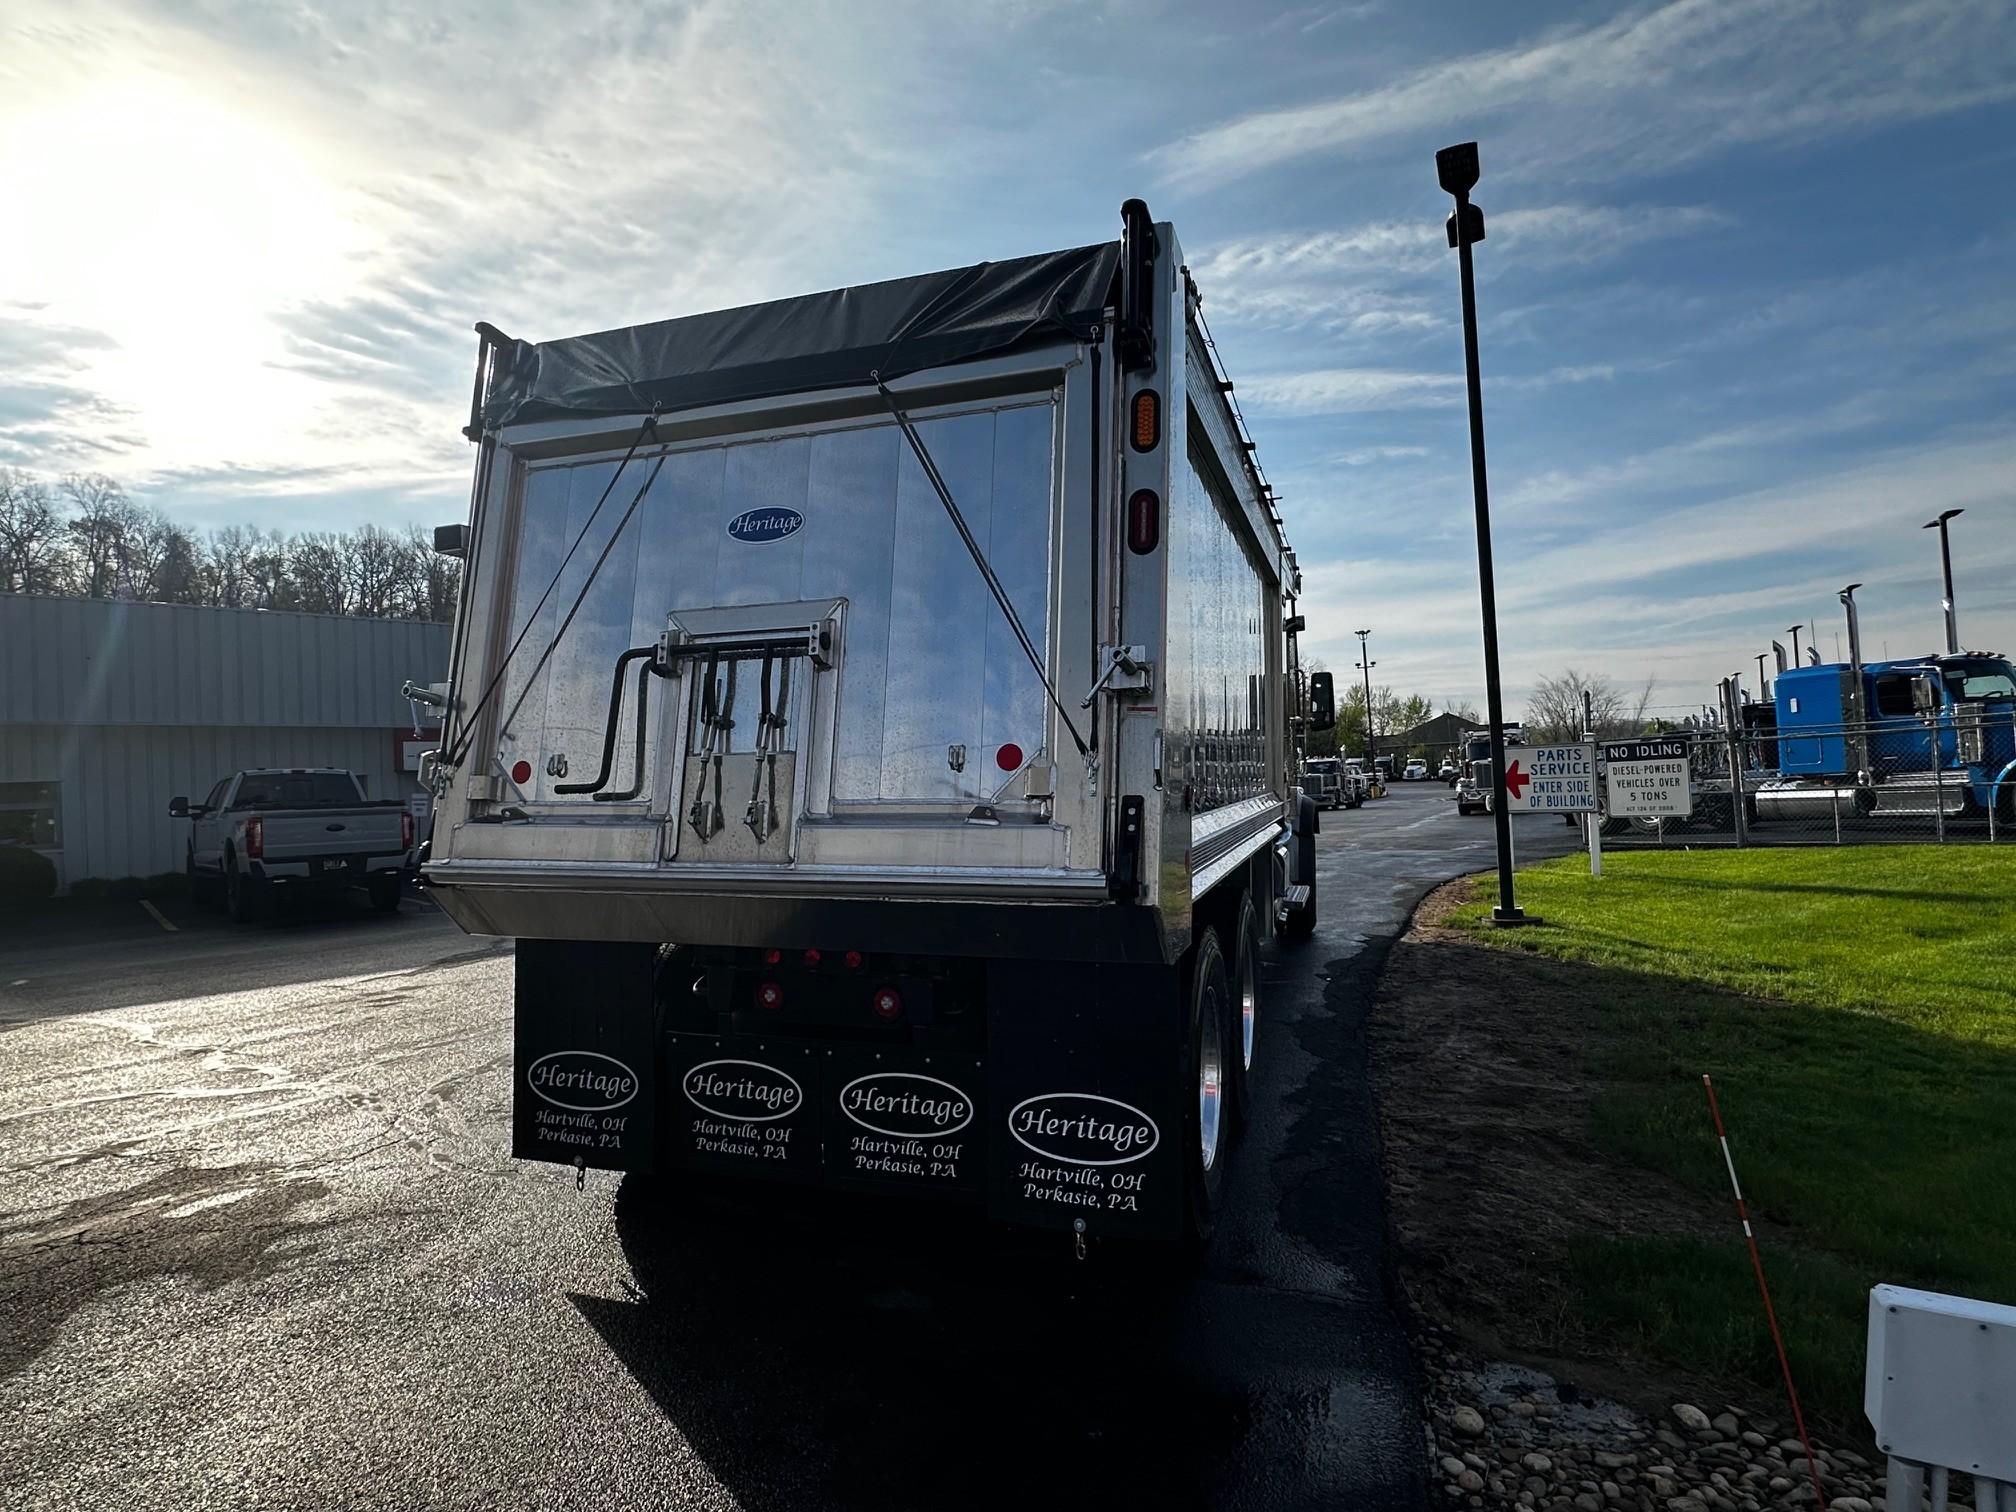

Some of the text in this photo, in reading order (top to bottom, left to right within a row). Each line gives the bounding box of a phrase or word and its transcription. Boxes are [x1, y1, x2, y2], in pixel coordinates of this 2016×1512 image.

[730, 513, 801, 534] Heritage
[1537, 748, 1582, 761] PARTS
[1610, 743, 1682, 758] NO IDLING
[1530, 762, 1591, 776] SERVICE
[1612, 764, 1682, 776] DIESEL-POWERED
[1533, 781, 1590, 793] ENTER SIDE
[1616, 777, 1680, 788] VEHICLES OVER
[1530, 794, 1594, 807] OF BUILDING
[1630, 791, 1668, 801] 5 TONS
[534, 1064, 631, 1099] Heritage
[690, 1073, 794, 1110] Heritage
[848, 1087, 964, 1125] Heritage
[534, 1110, 628, 1132] Hartville, OH
[692, 1119, 793, 1143] Hartville, OH
[1017, 1108, 1149, 1152] Heritage
[538, 1127, 621, 1148] Perkasie, PA
[696, 1137, 787, 1159] Perkasie, PA
[850, 1136, 963, 1160] Hartville, OH
[855, 1155, 957, 1178] Perkasie, PA
[1018, 1162, 1146, 1191] Hartville, OH
[1023, 1183, 1138, 1211] Perkasie, PA
